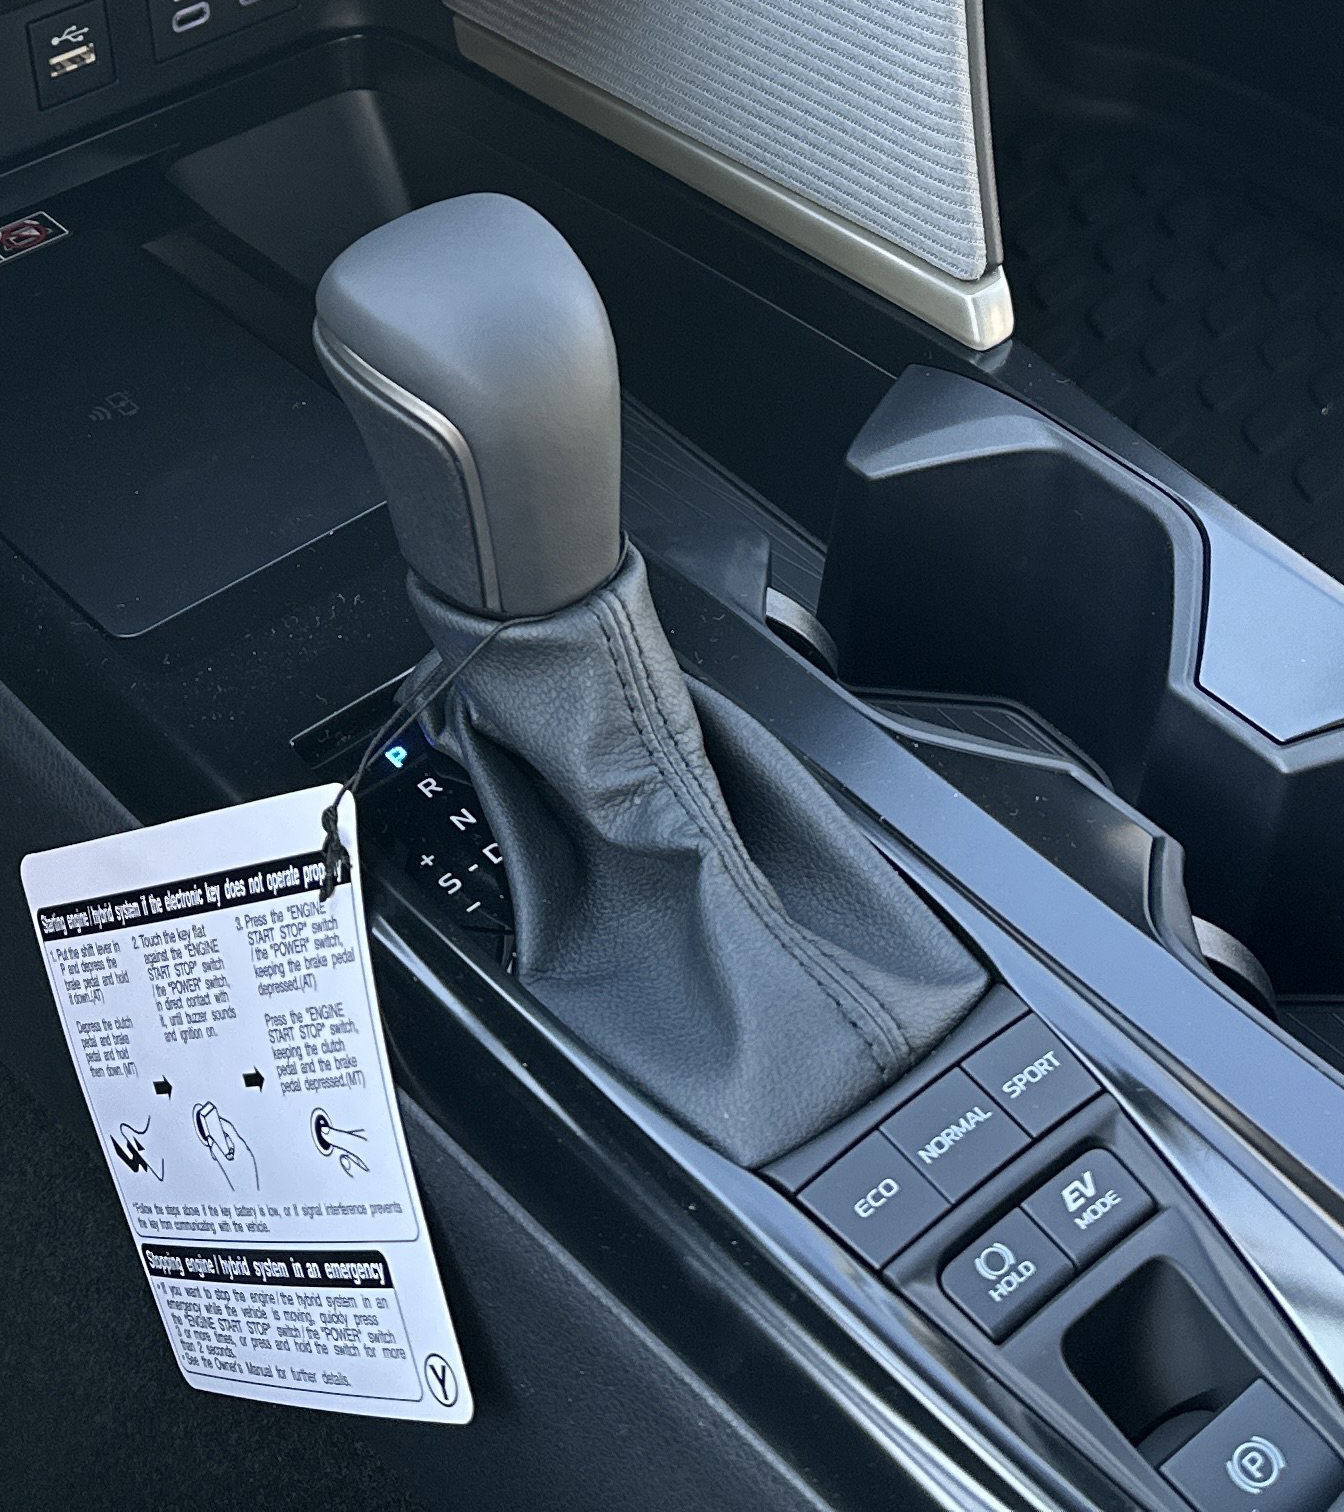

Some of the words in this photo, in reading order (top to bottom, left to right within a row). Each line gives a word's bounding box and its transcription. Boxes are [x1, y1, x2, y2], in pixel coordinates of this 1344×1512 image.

[384, 746, 408, 768] P
[417, 777, 443, 798] R
[449, 808, 477, 831] N
[115, 897, 140, 925] system
[149, 894, 163, 915] the
[164, 884, 204, 913] electronic
[204, 881, 221, 907] key
[223, 877, 246, 900] does
[248, 872, 263, 895] not
[266, 865, 300, 896] operate
[303, 859, 343, 890] propy
[438, 872, 462, 895] S
[244, 913, 268, 929] Press
[270, 909, 284, 924] the
[247, 926, 275, 946] START
[311, 914, 339, 934] switch
[140, 933, 163, 949] Touch
[163, 930, 176, 943] the
[176, 927, 192, 944] key
[191, 924, 207, 938] flat
[255, 946, 269, 961] the
[313, 932, 344, 951] switch,
[170, 946, 183, 960] the
[253, 962, 285, 980] keeping
[287, 958, 301, 973] the
[303, 953, 328, 970] brake
[331, 946, 356, 969] pedal
[147, 964, 170, 981] START
[264, 1013, 287, 1028] Press
[289, 1010, 303, 1024] the
[267, 1026, 295, 1044] START
[329, 1018, 359, 1036] switch,
[271, 1044, 303, 1063] keeping
[304, 1042, 318, 1056] the
[320, 1038, 346, 1054] clutch
[276, 1061, 298, 1079] pedal
[300, 1059, 316, 1074] and
[318, 1057, 332, 1072] the
[333, 1053, 358, 1069] brake
[1001, 1050, 1062, 1099] SPORT
[280, 1078, 302, 1096] pedal
[917, 1105, 993, 1164] NORMAL
[853, 1177, 900, 1219] ECO
[1060, 1170, 1098, 1213] EV
[1073, 1189, 1122, 1230] MODE
[145, 1249, 185, 1276] Stopping
[253, 1259, 289, 1282] system
[290, 1257, 305, 1278] in
[306, 1260, 322, 1279] an
[324, 1261, 385, 1285] emergency
[987, 1259, 1037, 1302] HOLD
[429, 1364, 449, 1400] Y
